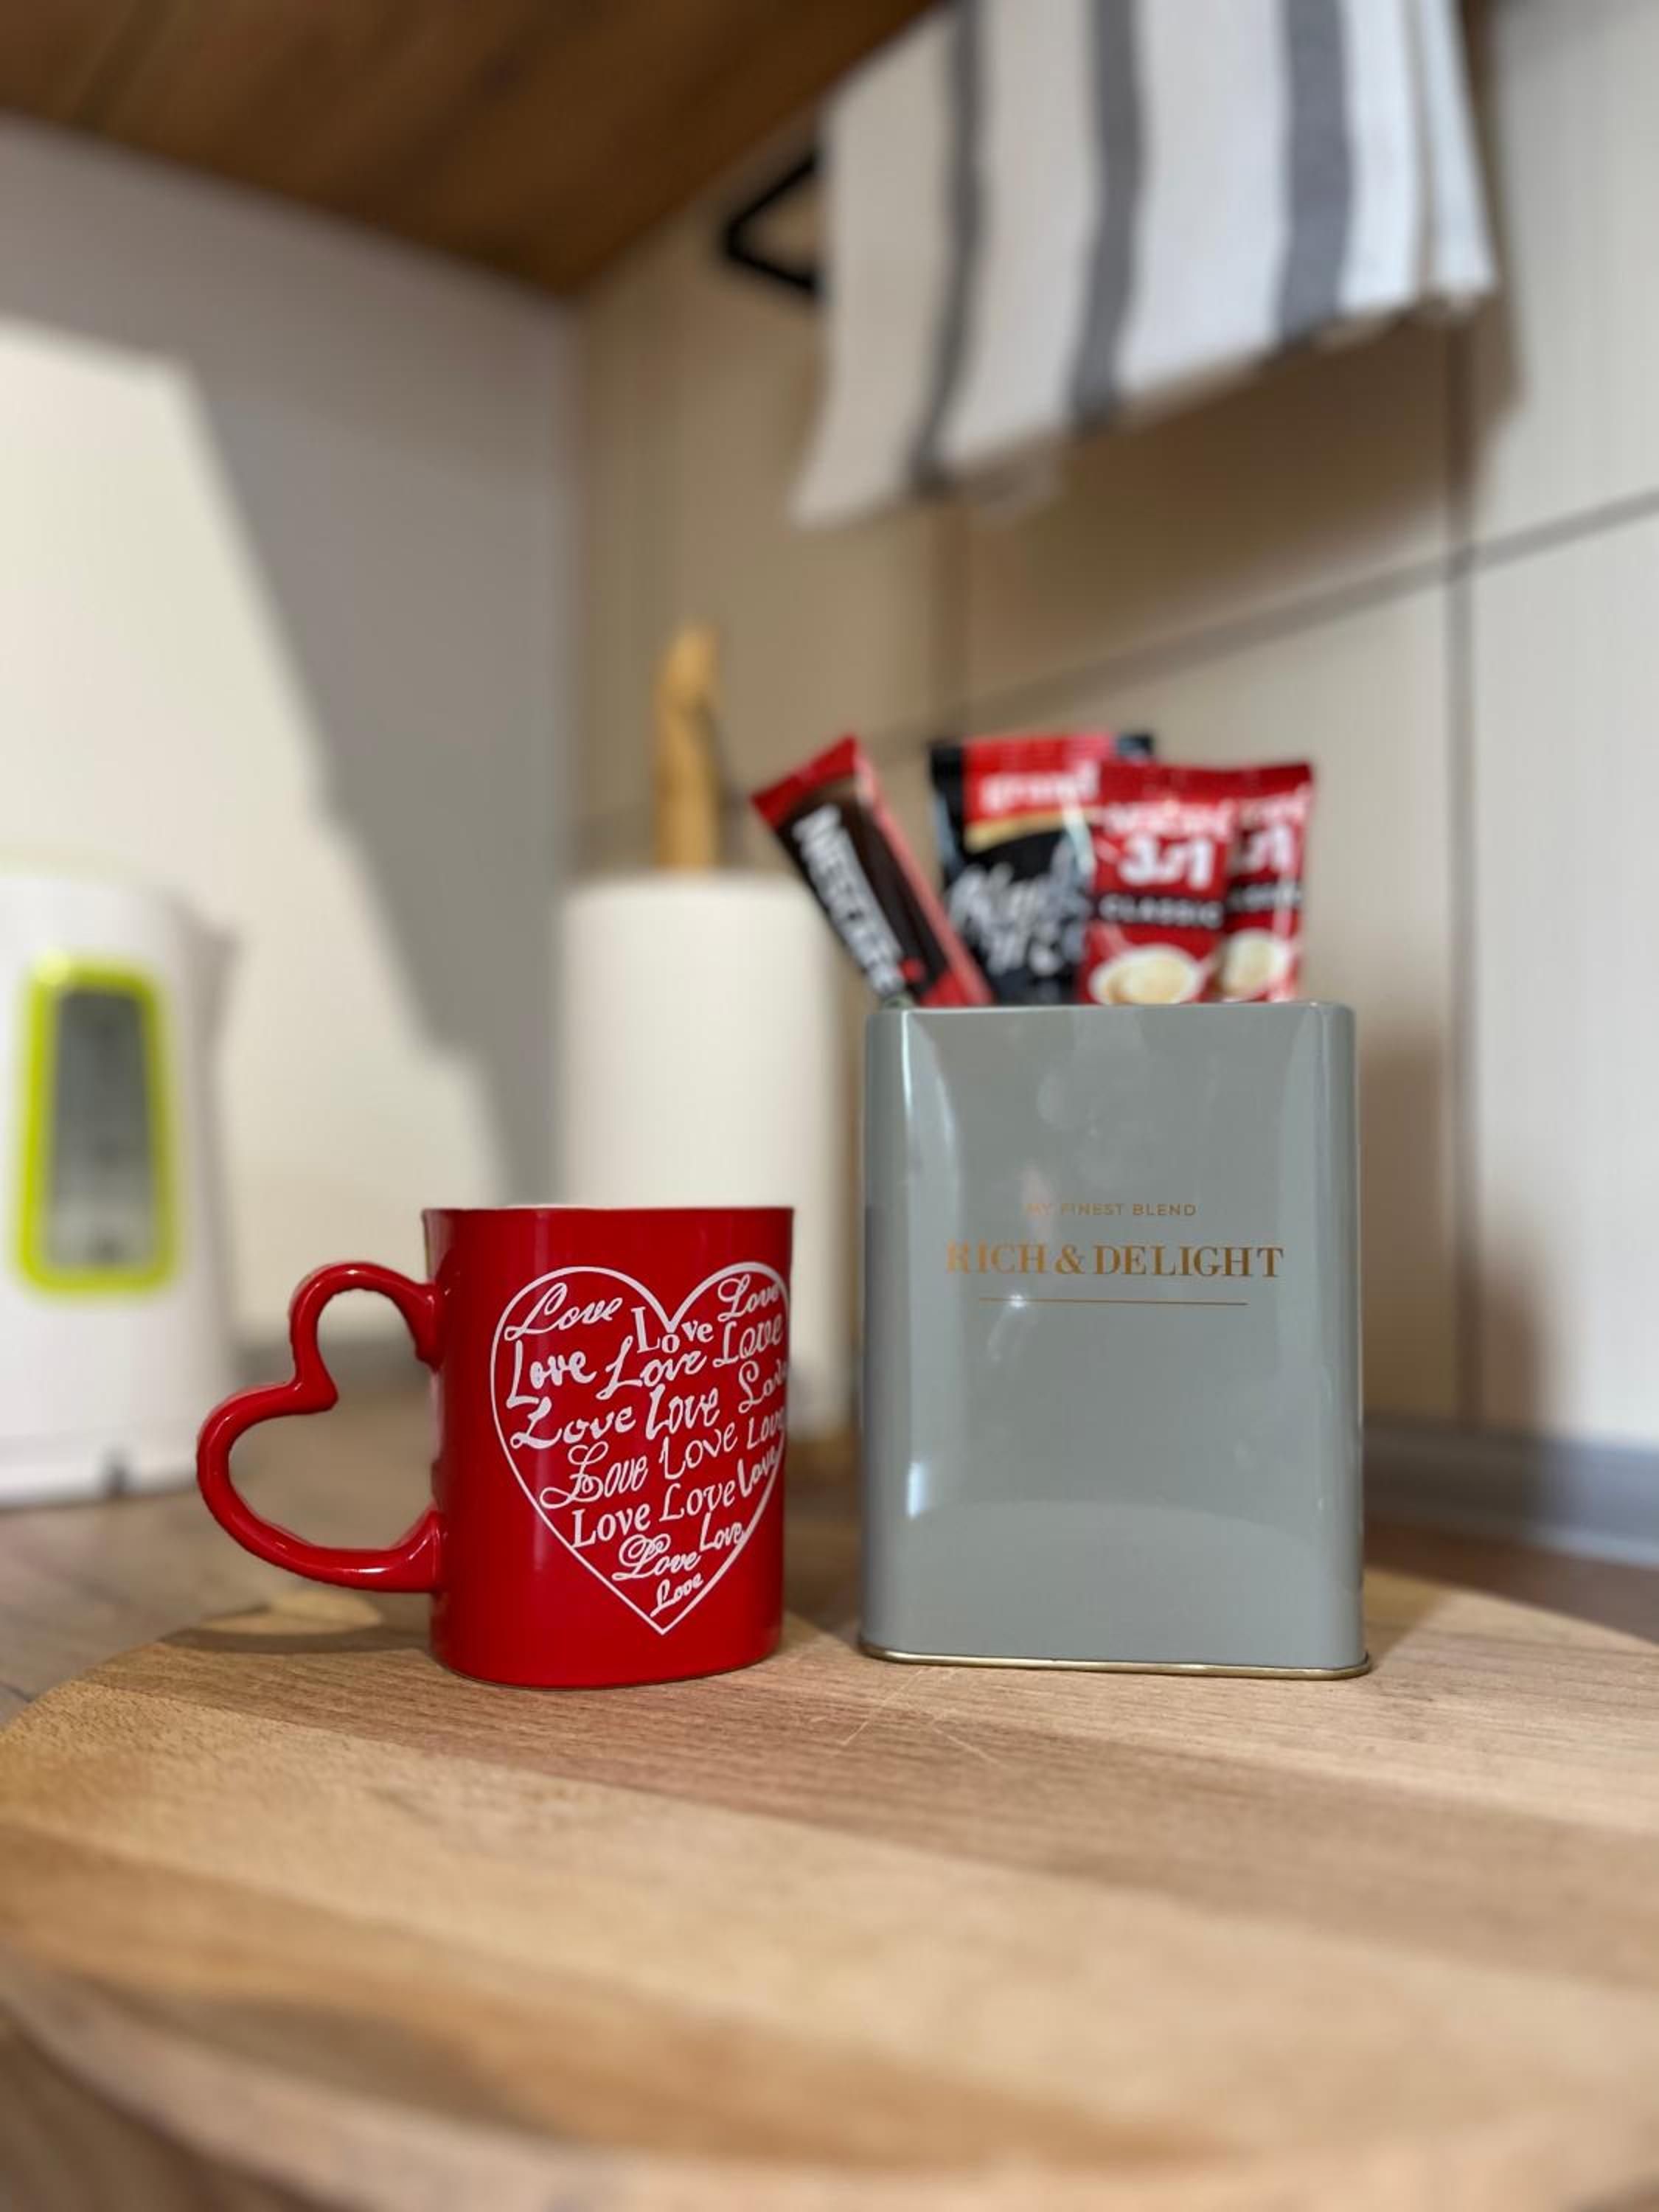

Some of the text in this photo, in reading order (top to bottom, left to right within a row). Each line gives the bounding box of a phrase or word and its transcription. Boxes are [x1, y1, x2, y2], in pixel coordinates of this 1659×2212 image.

[1061, 1203, 1124, 1216] FINEST
[1133, 1203, 1197, 1217] BLEND
[1092, 1245, 1284, 1278] DELIGHT
[504, 1282, 622, 1340] Love
[717, 1273, 779, 1322] Love
[631, 1307, 714, 1354] Love
[712, 1313, 783, 1368] Love
[506, 1340, 597, 1409] Love
[596, 1335, 706, 1400] Love
[509, 1396, 636, 1449] Love
[645, 1383, 720, 1442] Love
[540, 1441, 648, 1509] Love
[658, 1422, 737, 1480] Love
[572, 1501, 650, 1548] Love
[658, 1480, 735, 1523] Love
[699, 1512, 744, 1553] Love
[612, 1534, 701, 1582] Love
[650, 1573, 703, 1618] Love
